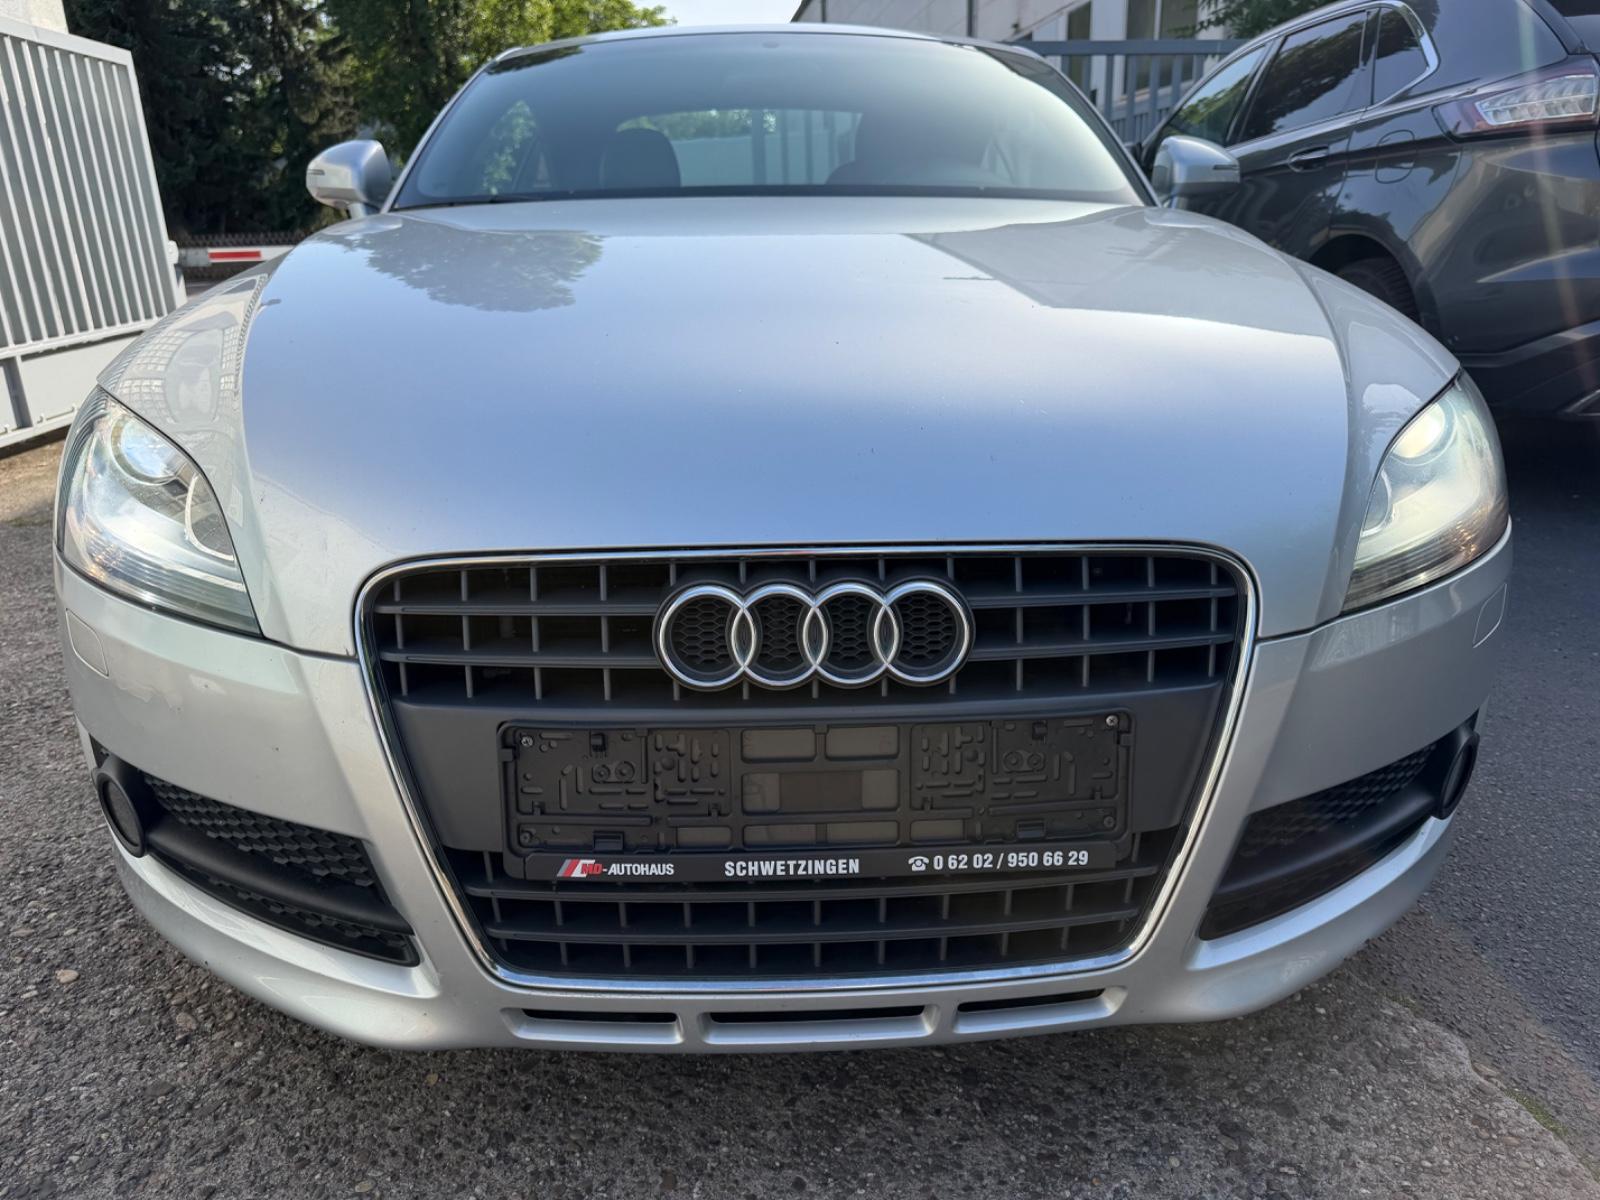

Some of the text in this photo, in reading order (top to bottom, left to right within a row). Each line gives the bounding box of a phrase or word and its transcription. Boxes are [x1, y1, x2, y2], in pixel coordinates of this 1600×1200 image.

[724, 858, 860, 877] SCHWETZINGEN
[933, 855, 944, 870] 0
[948, 854, 968, 870] 62
[973, 853, 993, 869] 02
[1007, 852, 1038, 867] 950
[1043, 851, 1063, 866] 66
[1067, 850, 1089, 866] 29
